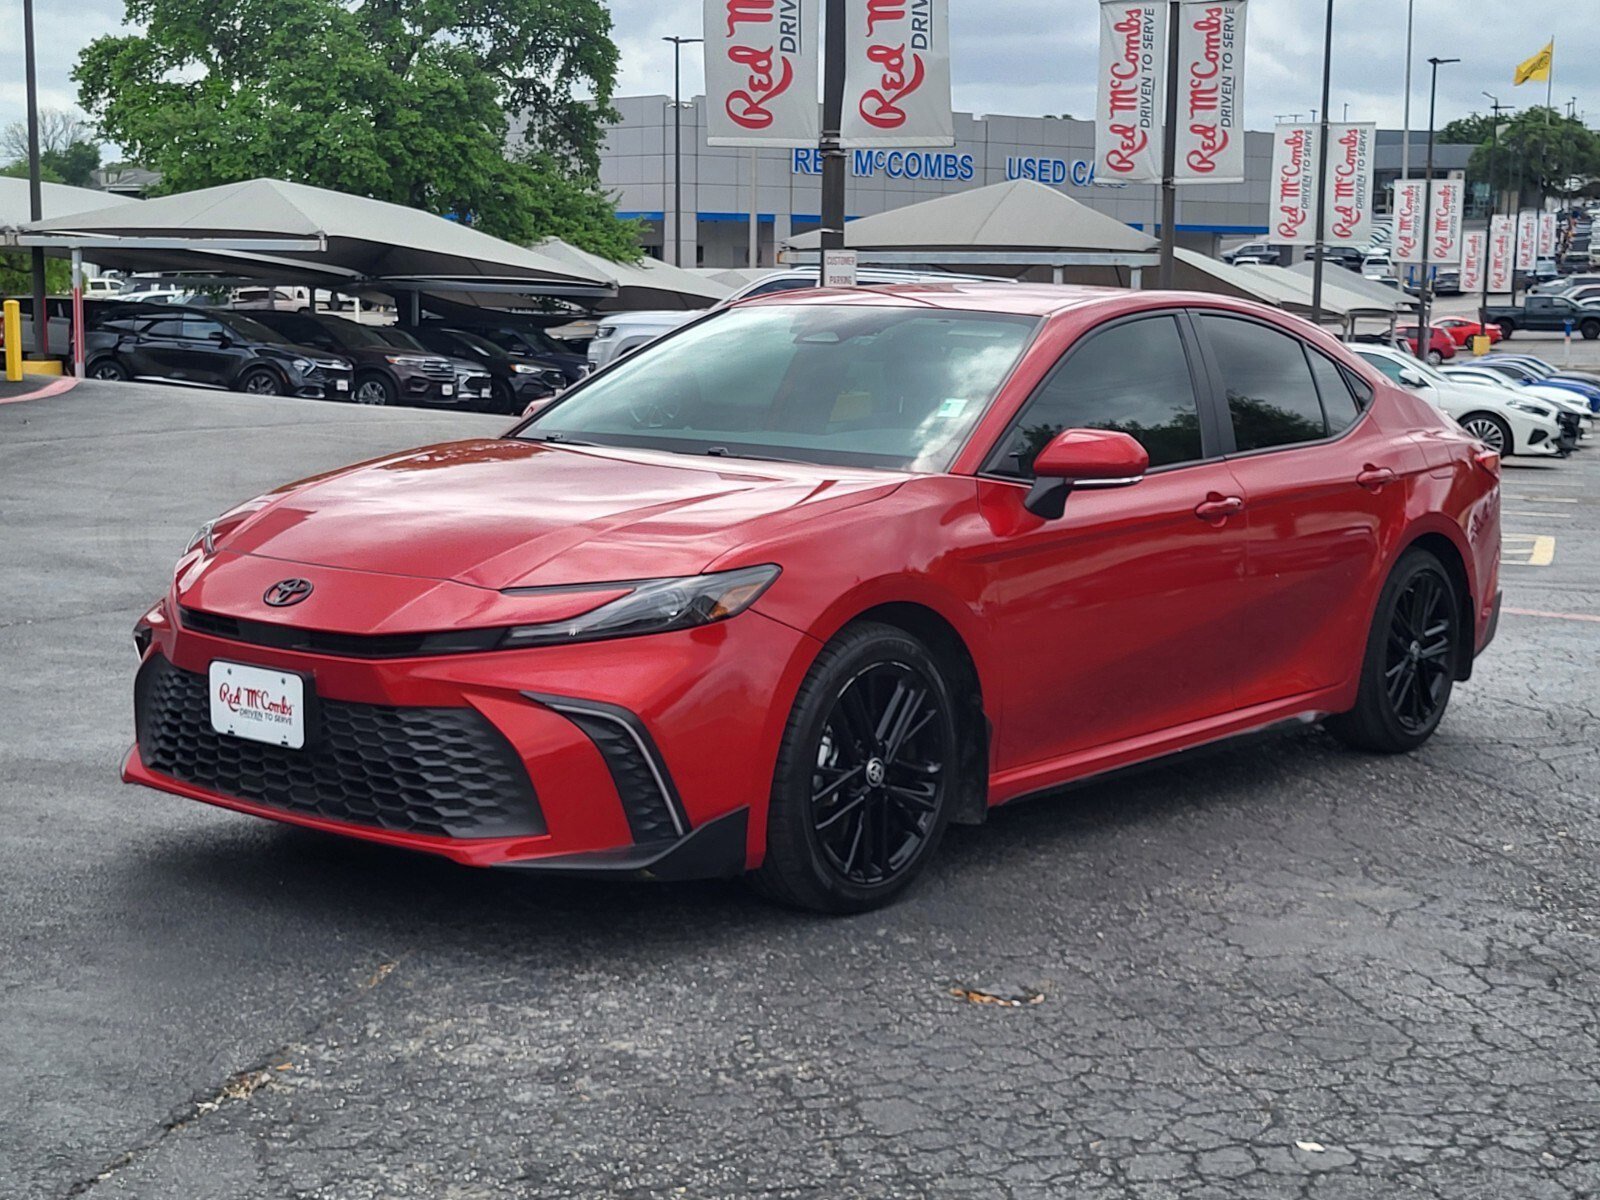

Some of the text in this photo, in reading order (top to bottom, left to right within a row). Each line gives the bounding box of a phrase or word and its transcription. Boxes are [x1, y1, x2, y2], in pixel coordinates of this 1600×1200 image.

[726, 46, 793, 129] Red
[859, 44, 925, 129] Red
[1106, 8, 1147, 172] Red McCombs
[1140, 8, 1155, 128] DRIVEN TO SERVE
[1187, 7, 1228, 172] Red McCombs
[1221, 7, 1235, 128] DRIVEN TO SERVE
[793, 148, 823, 173] RE
[1007, 157, 1066, 183] USED
[1278, 129, 1306, 237] Red McCombs
[1303, 160, 1311, 174] TO
[1332, 129, 1360, 238] Red McCombs
[1357, 160, 1365, 174] TO
[219, 683, 293, 716] Red McCombs
[240, 708, 293, 726] DRIVEN TO SERVE
